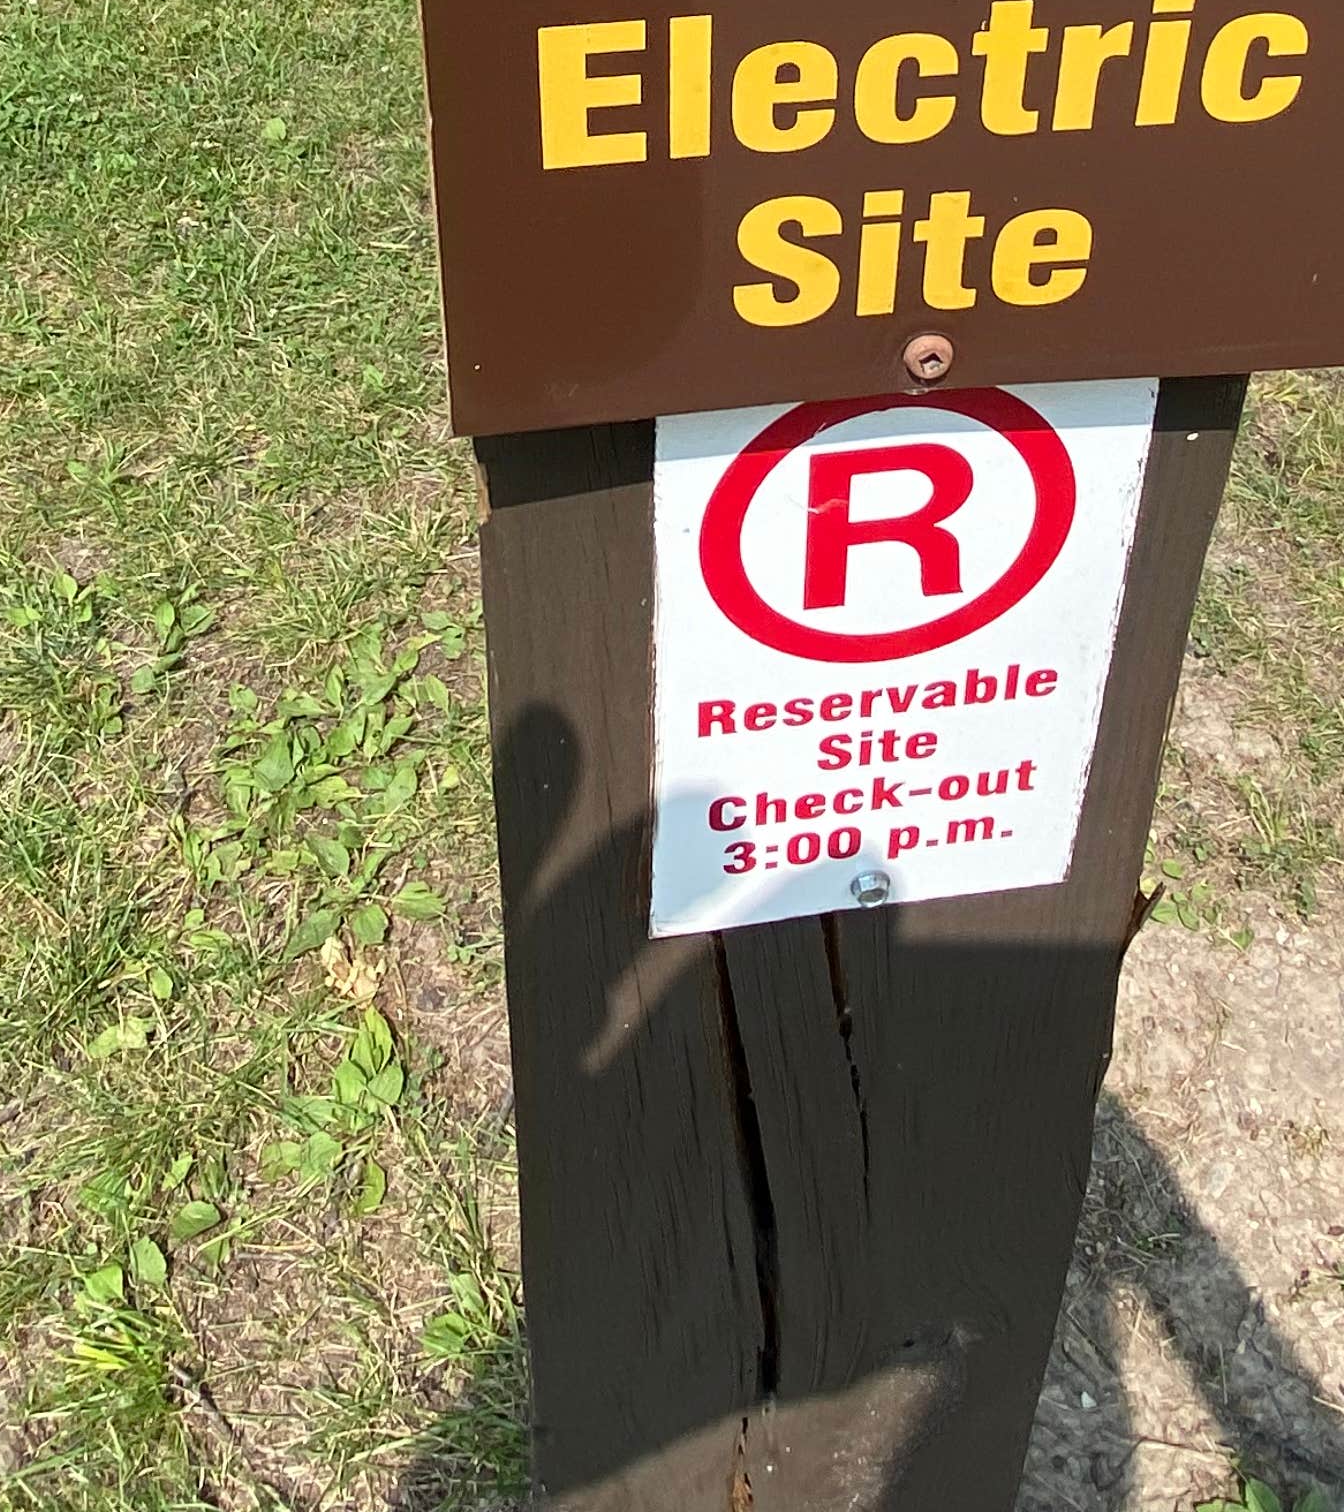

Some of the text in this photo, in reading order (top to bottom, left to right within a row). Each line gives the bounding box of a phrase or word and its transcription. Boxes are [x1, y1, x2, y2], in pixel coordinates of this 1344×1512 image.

[732, 191, 1094, 327] Site
[697, 663, 1058, 738] Reservable
[817, 730, 939, 771] Site
[708, 759, 1037, 832] Check-out
[722, 814, 1014, 875] 3:00 p.m.
